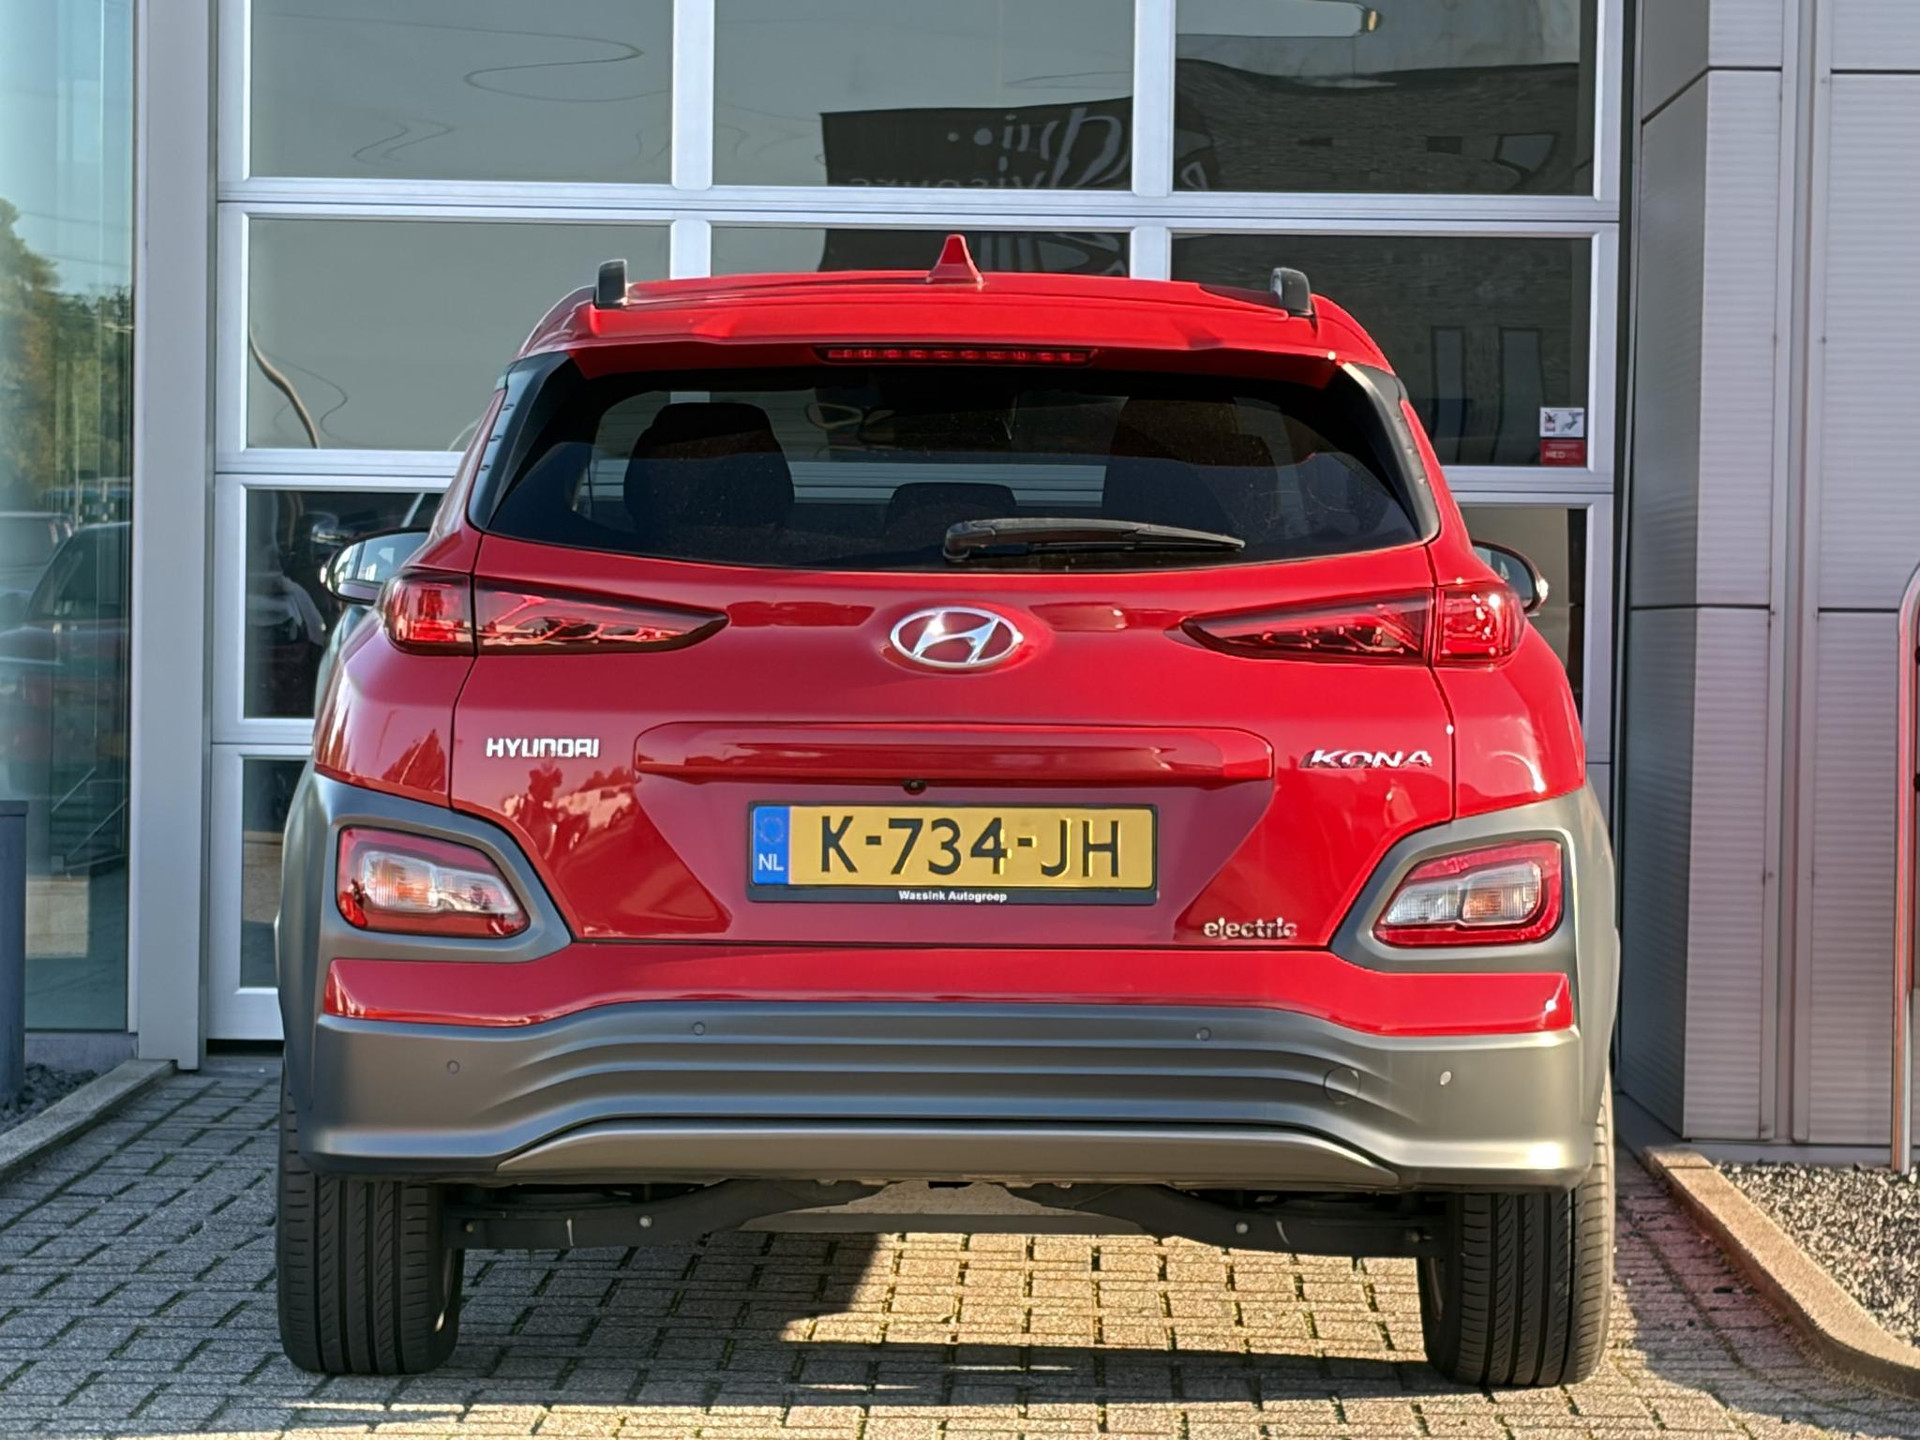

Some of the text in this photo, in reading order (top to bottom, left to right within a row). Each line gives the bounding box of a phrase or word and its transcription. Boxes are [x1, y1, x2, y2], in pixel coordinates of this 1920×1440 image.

[486, 737, 600, 758] HYUNDAI
[1302, 749, 1432, 768] KONA
[820, 814, 1120, 878] K-734-JH
[758, 853, 785, 871] NL
[898, 889, 1008, 903] Wassink Autogroep
[1203, 917, 1298, 939] electric
